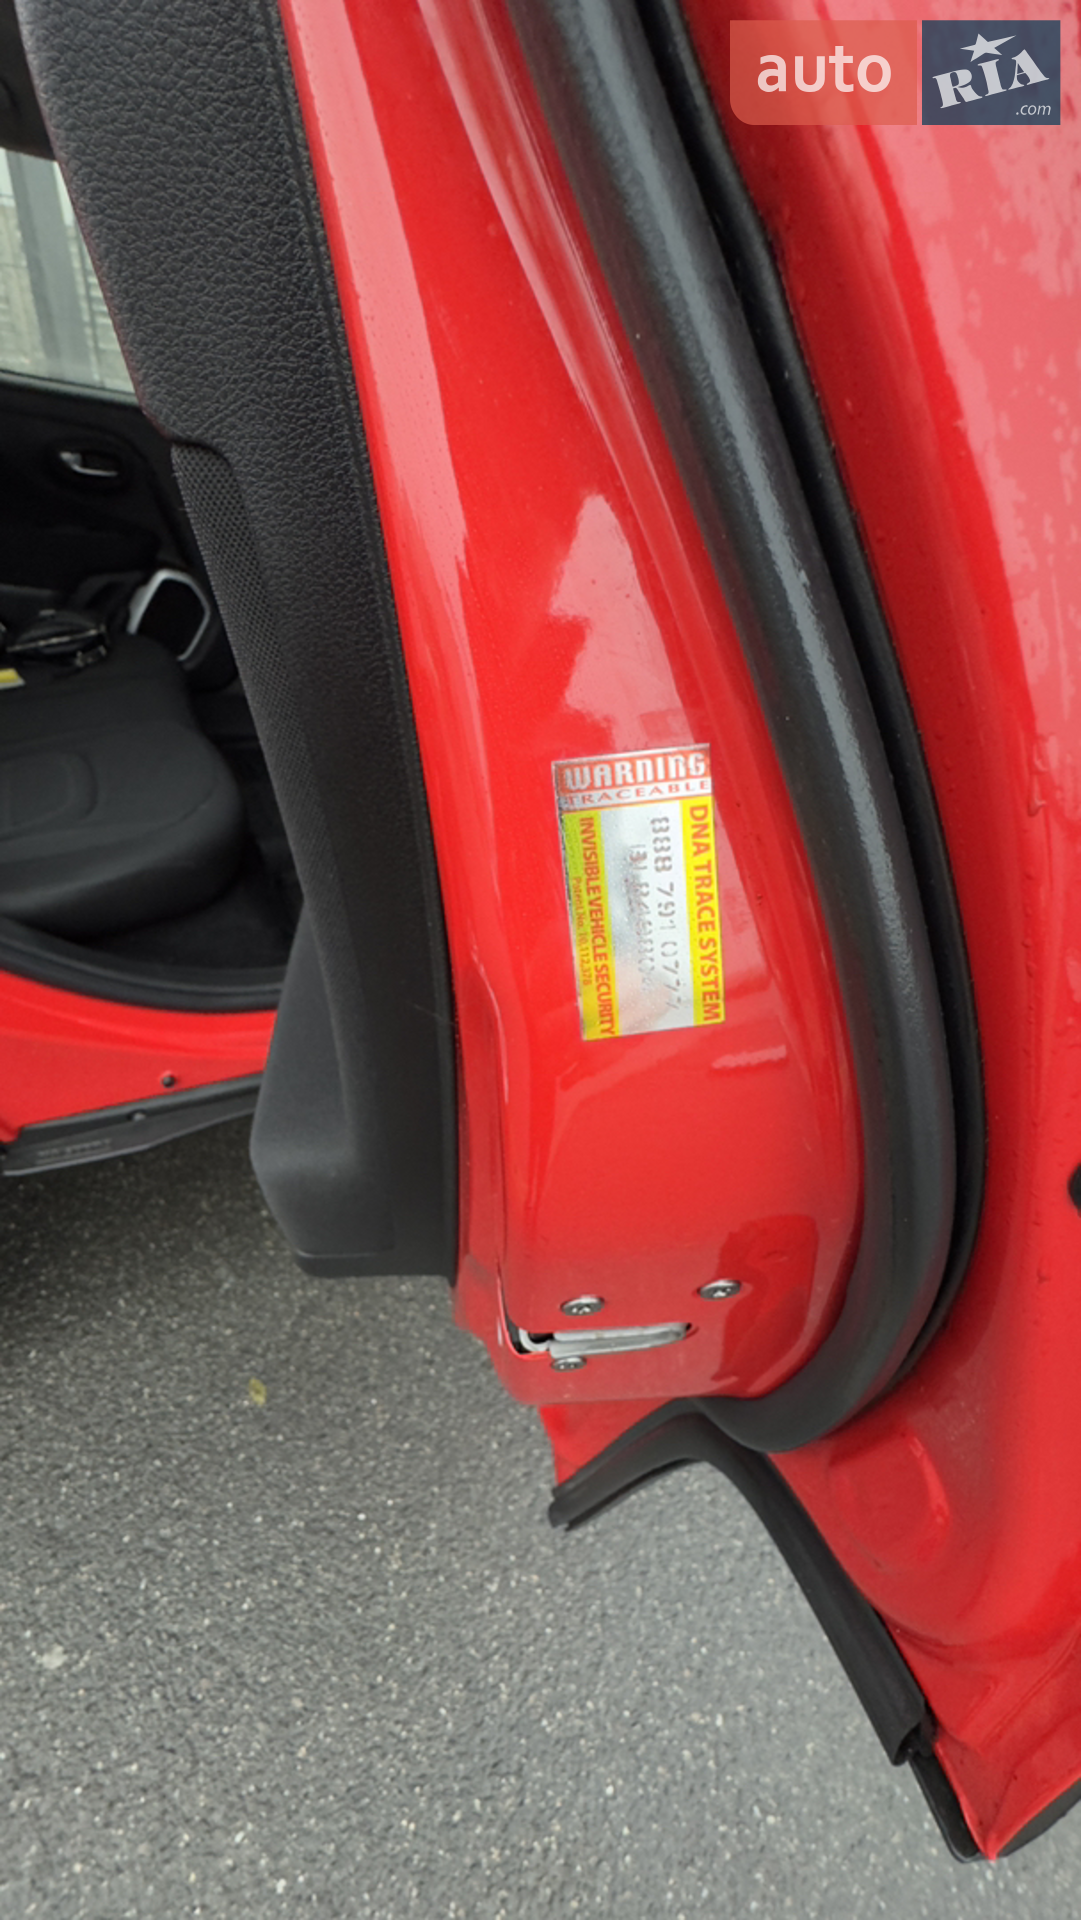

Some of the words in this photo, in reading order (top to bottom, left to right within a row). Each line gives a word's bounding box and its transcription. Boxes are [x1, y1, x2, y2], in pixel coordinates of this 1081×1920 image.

[564, 753, 706, 790] WARNING
[566, 780, 710, 806] TRACEABLE
[579, 817, 602, 896] INVISIBLE
[650, 817, 673, 874] 888
[689, 804, 713, 858] DNA
[587, 895, 609, 961] VEHICLE
[656, 882, 677, 931] 791
[693, 861, 717, 933] TRACE
[593, 965, 616, 1036] SECURITY
[660, 941, 682, 1011] 0777
[698, 938, 721, 1022] SYSTEM
